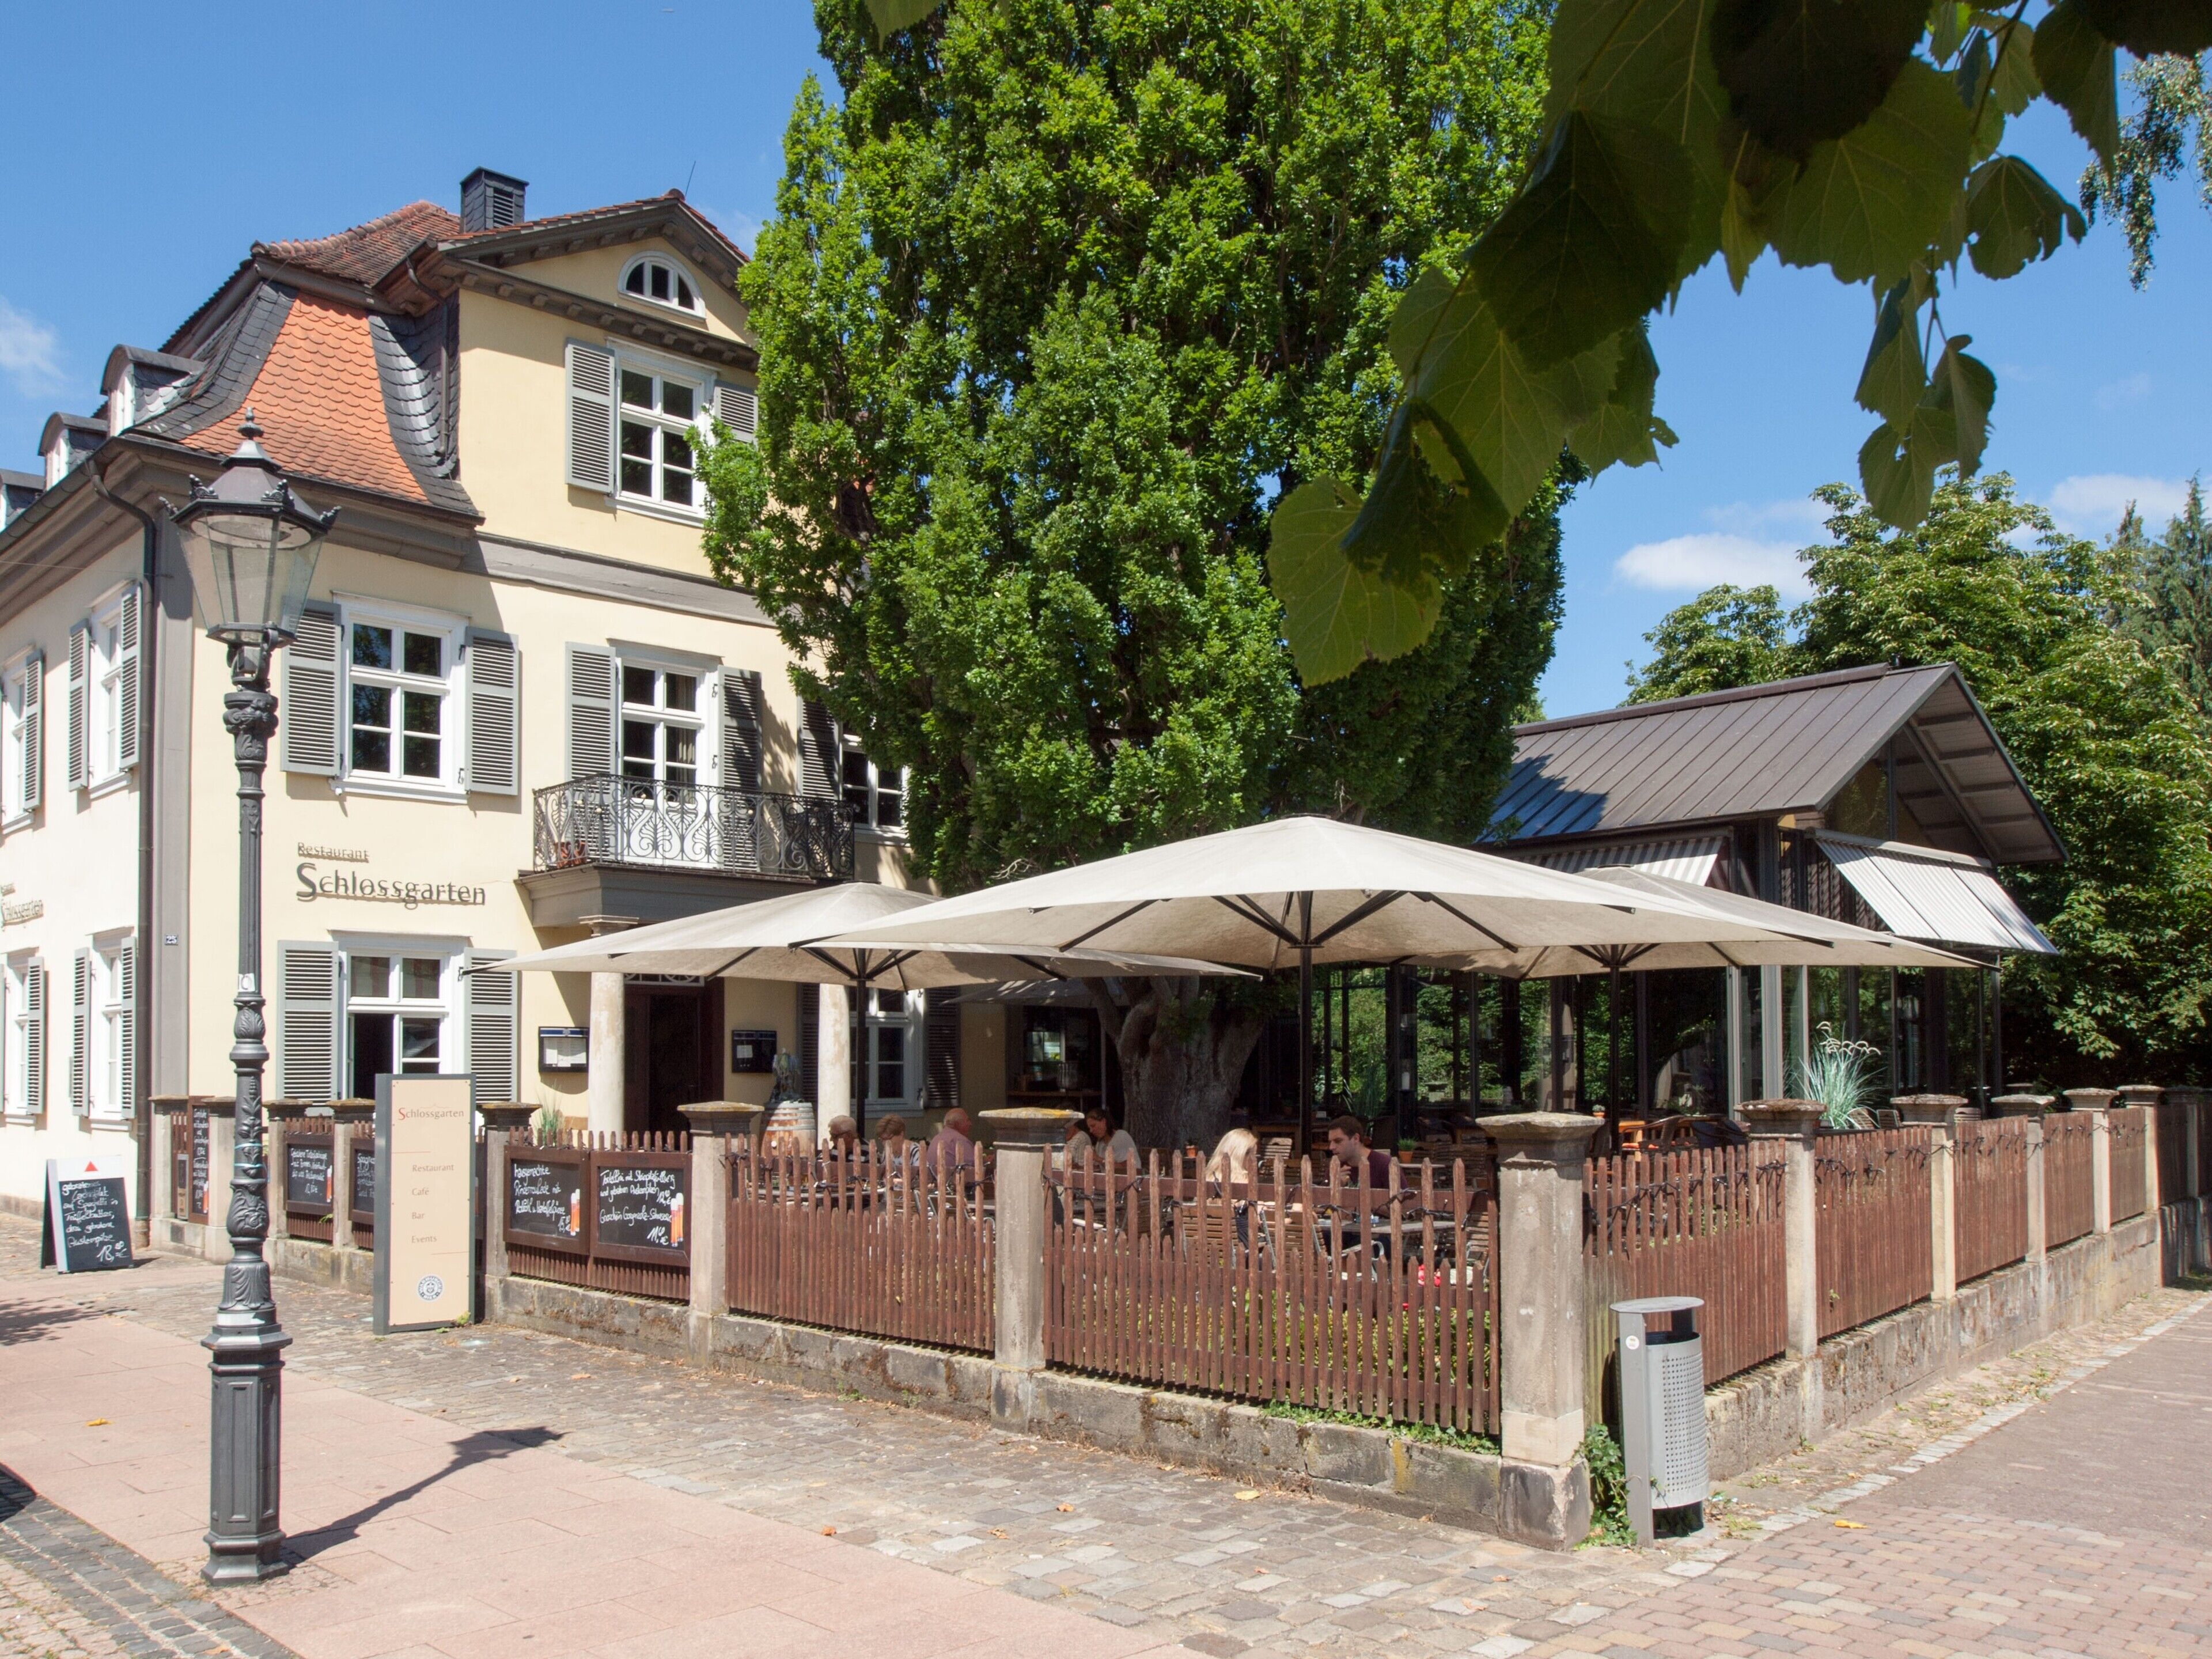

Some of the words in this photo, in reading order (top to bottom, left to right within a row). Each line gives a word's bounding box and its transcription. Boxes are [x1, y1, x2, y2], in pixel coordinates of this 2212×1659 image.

[298, 842, 369, 859] Restaurant
[296, 862, 485, 905] Schlossgarten
[166, 935, 176, 944] 25
[398, 1107, 464, 1120] Schlossgarten
[412, 1187, 429, 1196] Café
[411, 1235, 437, 1243] Events
